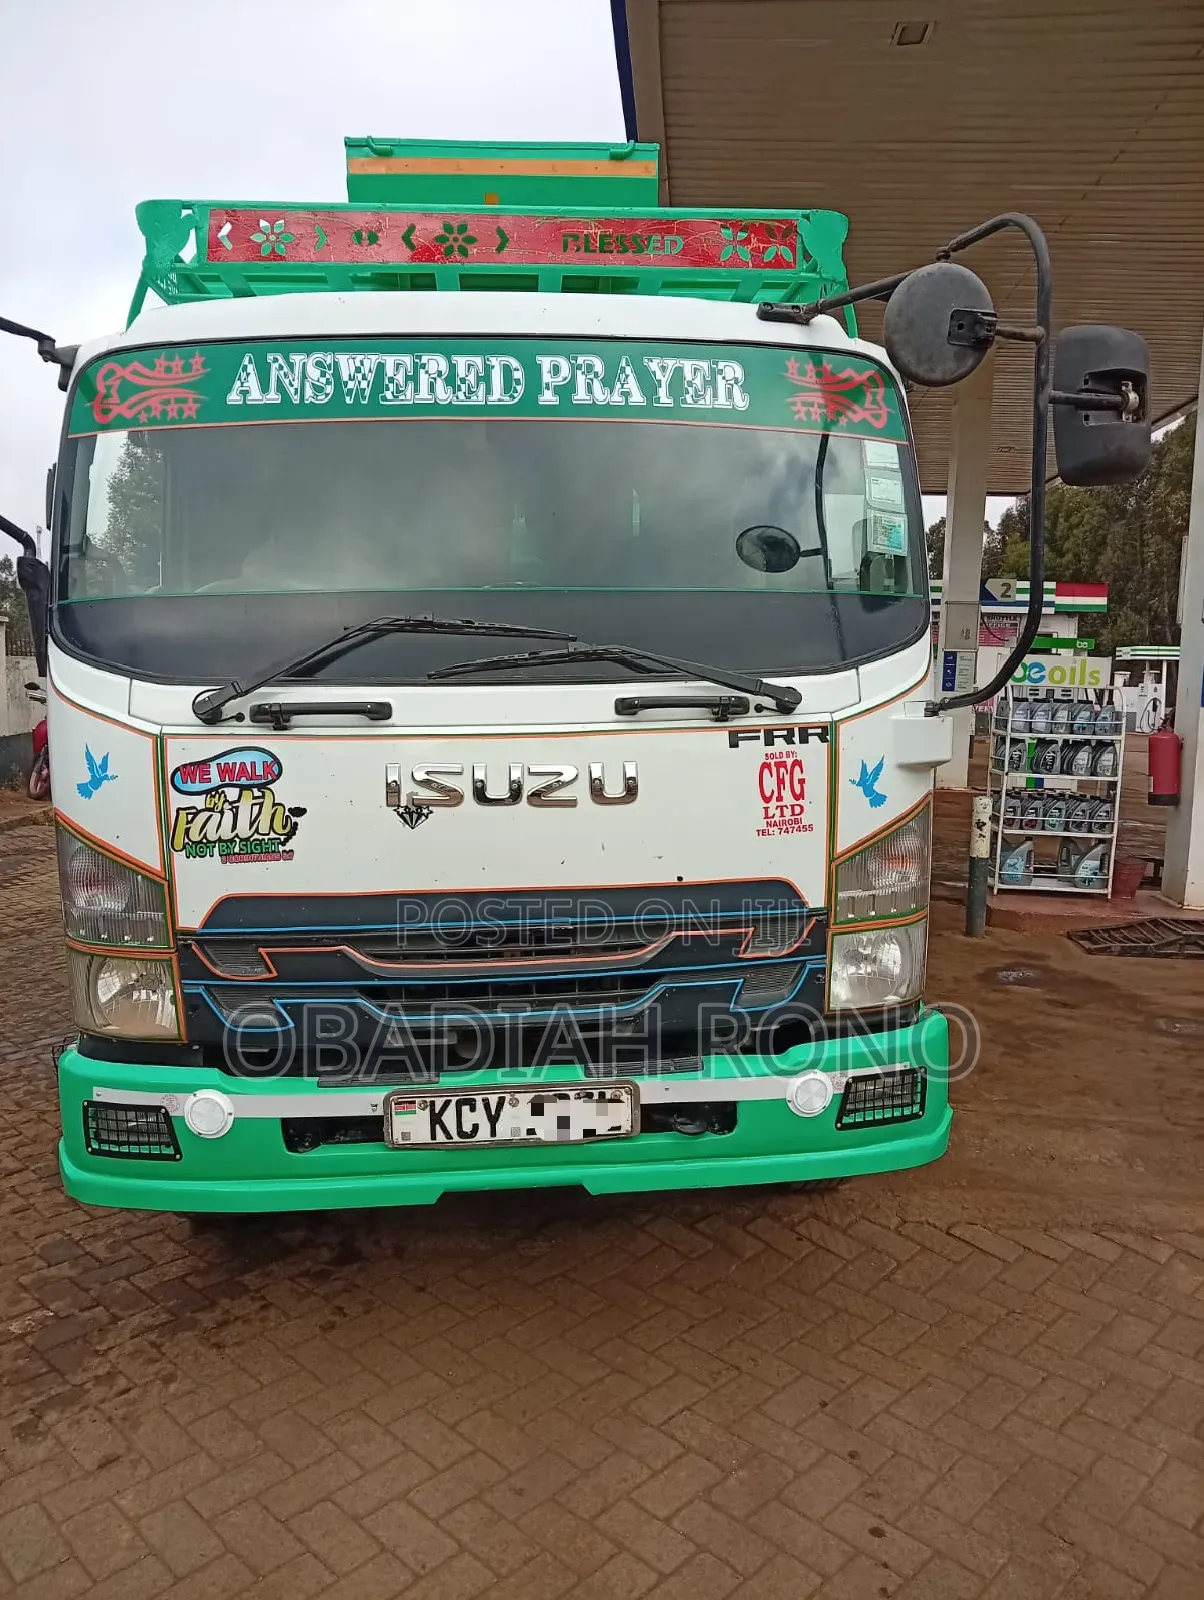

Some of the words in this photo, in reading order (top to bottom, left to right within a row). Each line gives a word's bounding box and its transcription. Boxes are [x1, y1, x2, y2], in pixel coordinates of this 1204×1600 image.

[562, 232, 684, 255] BLESSED
[226, 352, 525, 406] ANSWERED
[536, 353, 750, 411] PRAYER
[1000, 582, 1012, 599] 2
[728, 725, 830, 748] FRR
[764, 751, 784, 761] SOLD
[785, 750, 798, 759] BY:
[179, 762, 212, 785] WE
[216, 759, 279, 783] WALK
[758, 758, 806, 804] CFG
[385, 761, 639, 809] ISUZU
[204, 789, 228, 812] by
[762, 803, 805, 820] LTD
[170, 786, 293, 852] Faith
[756, 828, 776, 837] TEL:
[777, 823, 814, 835] 747455
[765, 816, 803, 829] NAIROBI
[184, 841, 216, 859] NOT
[218, 840, 236, 857] BY
[238, 838, 281, 855] SIGHT
[428, 1095, 506, 1141] KCY
